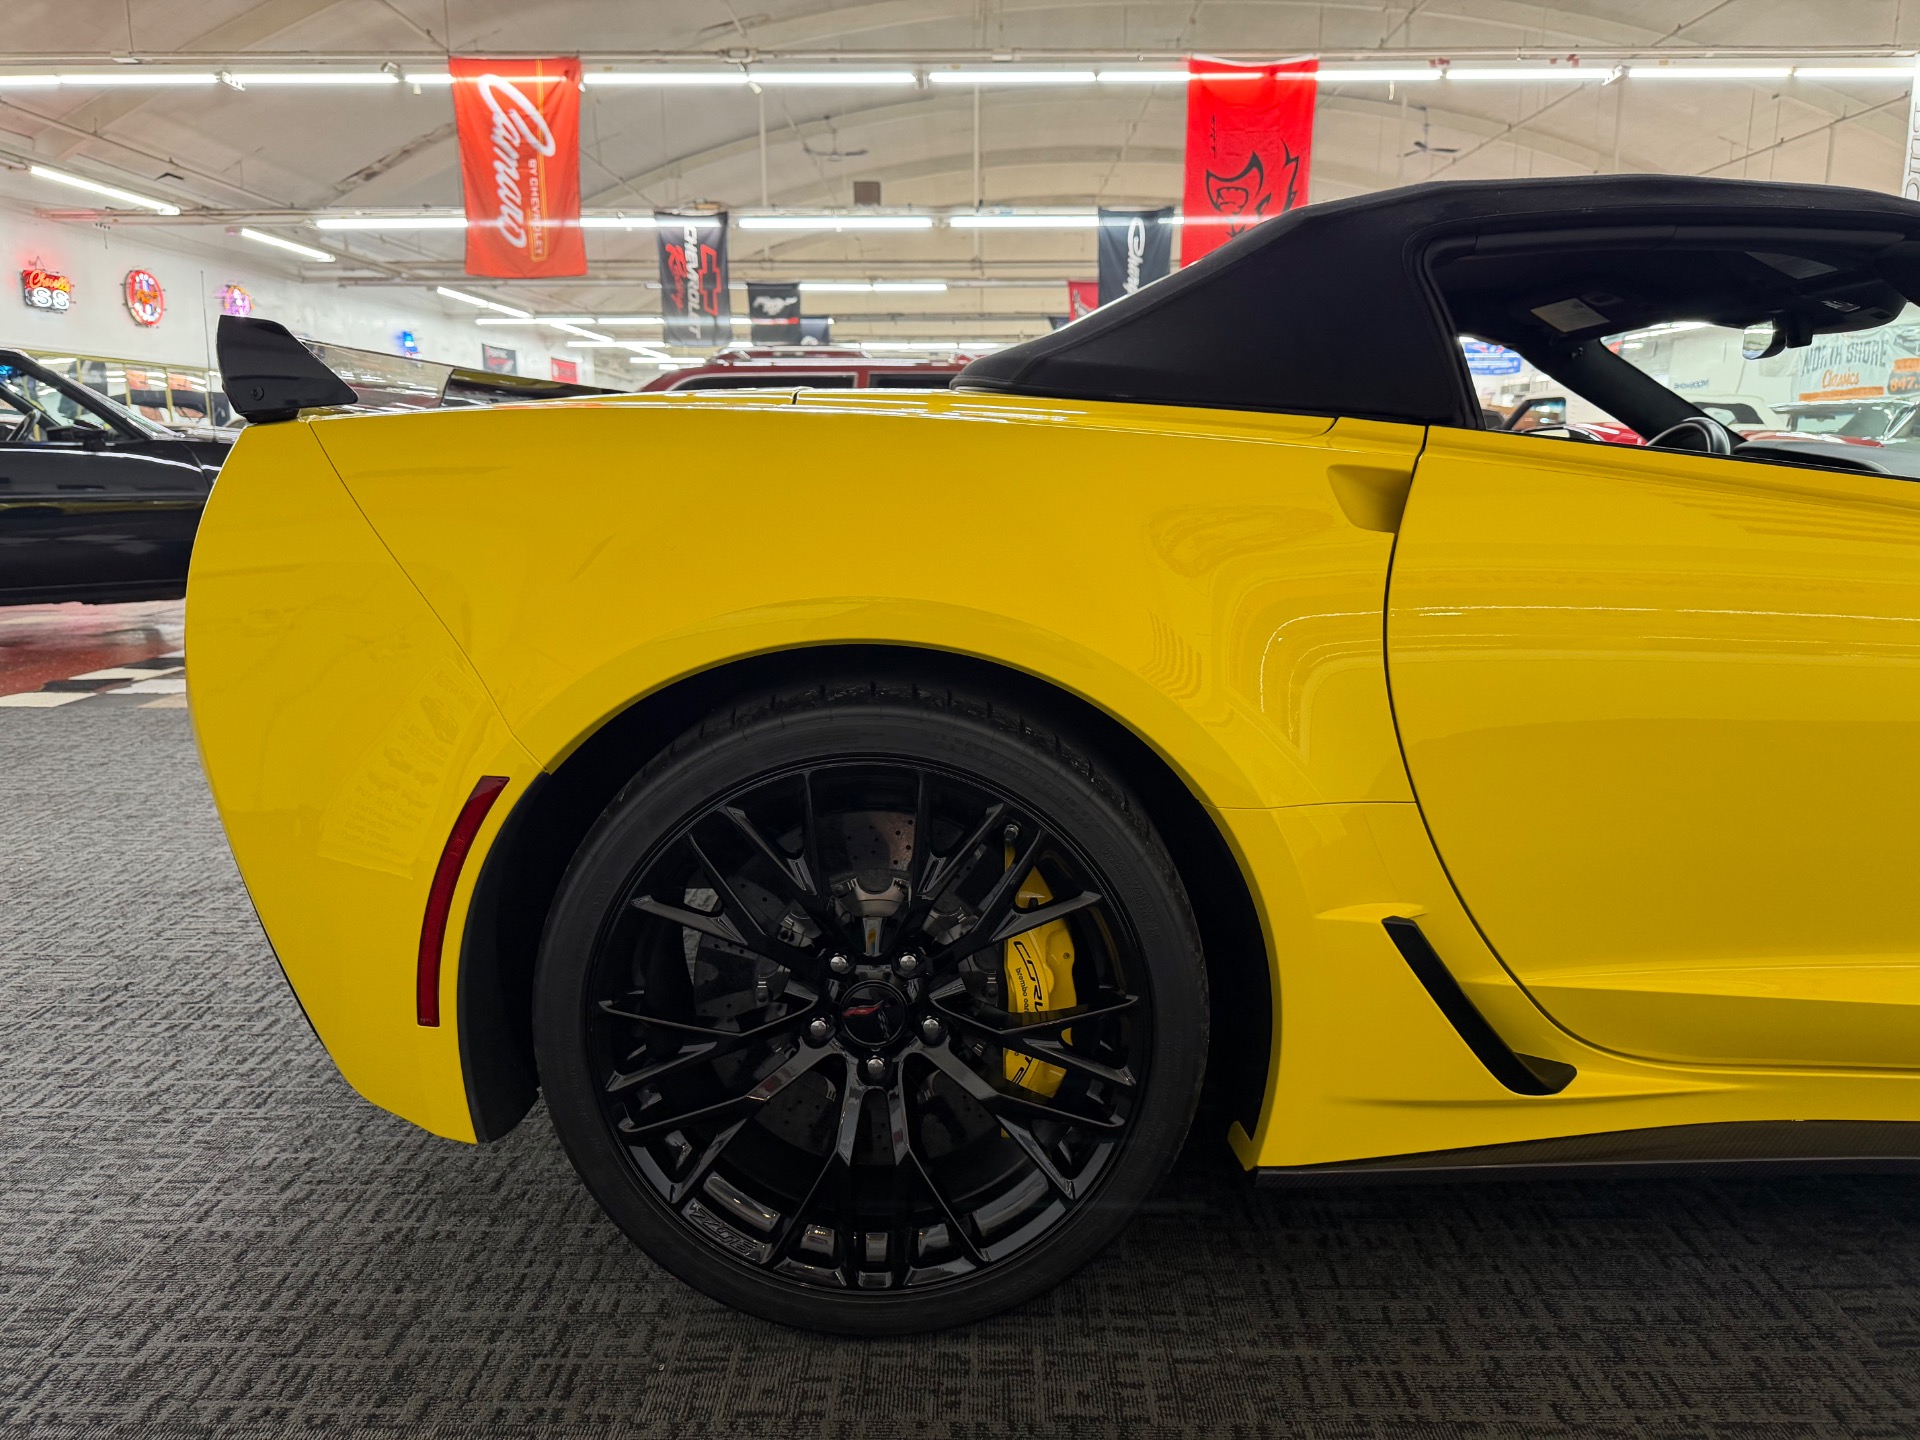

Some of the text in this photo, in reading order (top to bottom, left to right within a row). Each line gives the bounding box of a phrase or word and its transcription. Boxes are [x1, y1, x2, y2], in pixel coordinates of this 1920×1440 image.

[478, 74, 556, 248] Camaro
[528, 158, 543, 255] BY CHEVROLET
[684, 225, 701, 339] CHEVROLET
[1801, 343, 1843, 376] NORTH
[1846, 339, 1888, 368] SHORE
[1822, 368, 1859, 388] Classics
[1015, 967, 1028, 997] brembo
